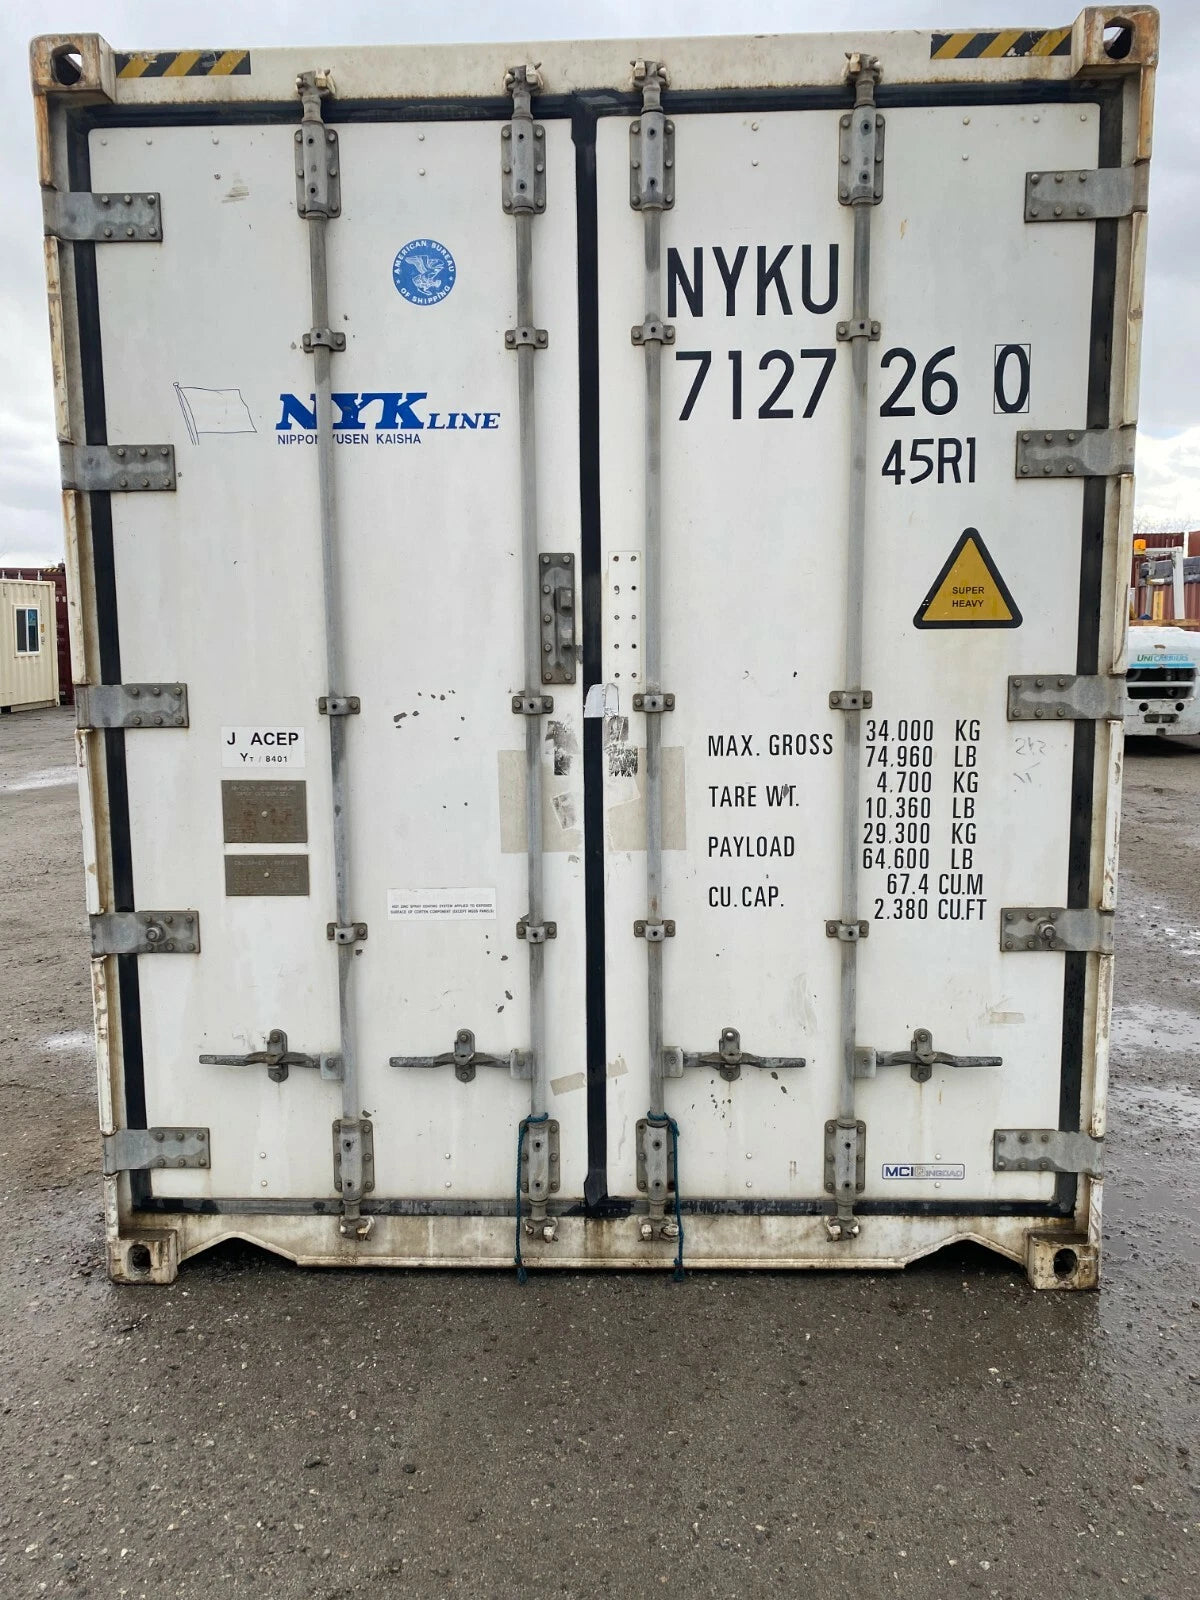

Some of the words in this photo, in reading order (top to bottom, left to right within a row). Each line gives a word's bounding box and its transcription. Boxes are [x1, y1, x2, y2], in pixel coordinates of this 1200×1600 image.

[394, 241, 427, 275] AMERICAN
[431, 242, 455, 272] BUREAU
[668, 244, 838, 317] NYKU
[400, 287, 411, 298] OF
[411, 285, 451, 305] SHIPPING
[993, 343, 1031, 414] 0
[275, 392, 427, 430] NYK
[427, 412, 501, 430] LINE
[332, 433, 369, 445] USEN
[376, 433, 422, 444] KAISHA
[882, 437, 975, 485] 45R1
[952, 586, 985, 595] SUPER
[952, 599, 985, 608] HEAVY
[227, 732, 236, 745] J
[251, 732, 299, 745] ACEP
[956, 720, 980, 741] KG
[709, 735, 759, 756] MAX.
[770, 734, 832, 755] GROSS
[265, 755, 288, 763] 8401
[955, 746, 976, 767] LB
[954, 772, 978, 793] KG
[709, 786, 756, 807] TARE
[766, 784, 798, 806] WT.
[953, 797, 974, 818] LB
[952, 823, 976, 844] KG
[709, 836, 794, 857] PAYLOAD
[952, 849, 972, 869] LB
[888, 874, 928, 894] 67.4
[939, 874, 982, 894] CU.M
[939, 899, 986, 920] CU.FT
[885, 1166, 914, 1177] MCI
